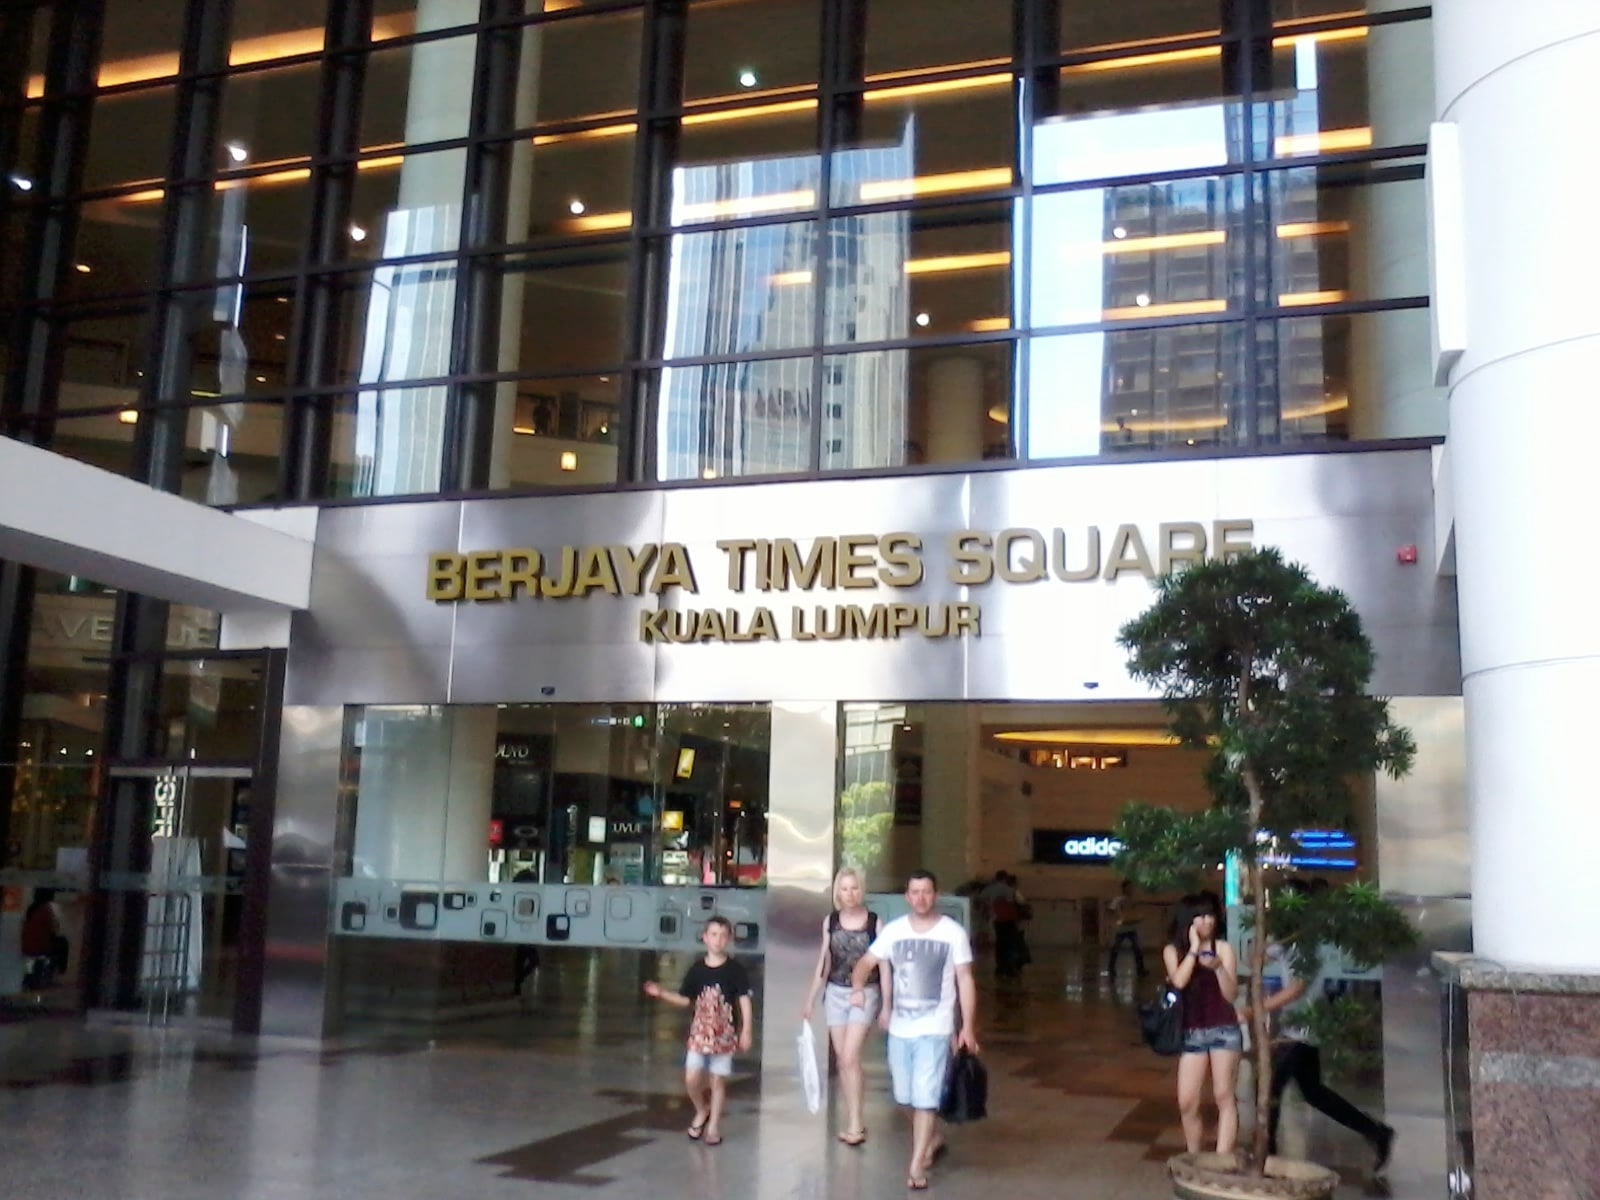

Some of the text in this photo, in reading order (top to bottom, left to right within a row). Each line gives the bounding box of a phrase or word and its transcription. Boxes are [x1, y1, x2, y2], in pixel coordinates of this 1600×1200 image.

[426, 518, 1254, 604] BERJAYA TIMES SQUARE
[639, 602, 981, 643] KUALA LUMPUR
[1064, 837, 1124, 857] adida
